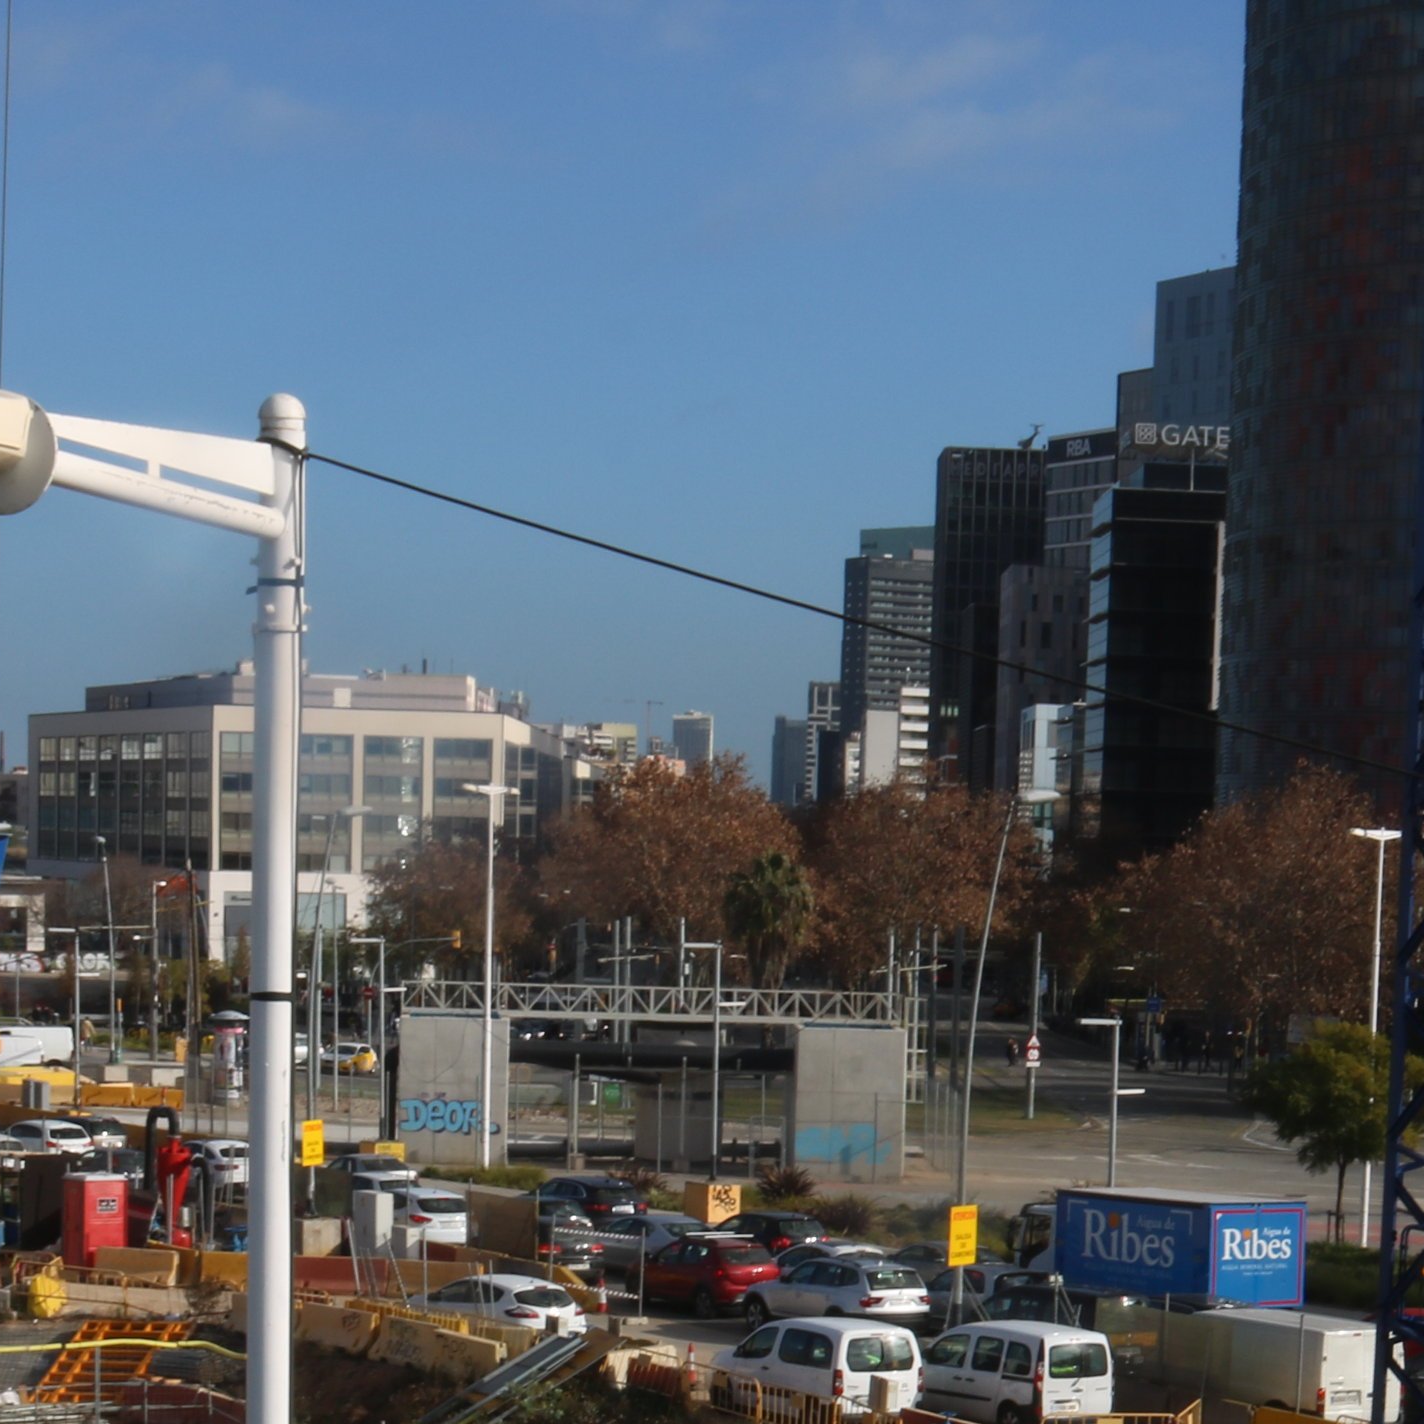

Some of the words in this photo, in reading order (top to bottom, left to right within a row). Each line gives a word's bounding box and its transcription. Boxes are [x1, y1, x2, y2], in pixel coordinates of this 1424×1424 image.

[1161, 424, 1230, 448] GATE
[1081, 1208, 1175, 1268] Ribes
[1222, 1227, 1292, 1260] Ribes
